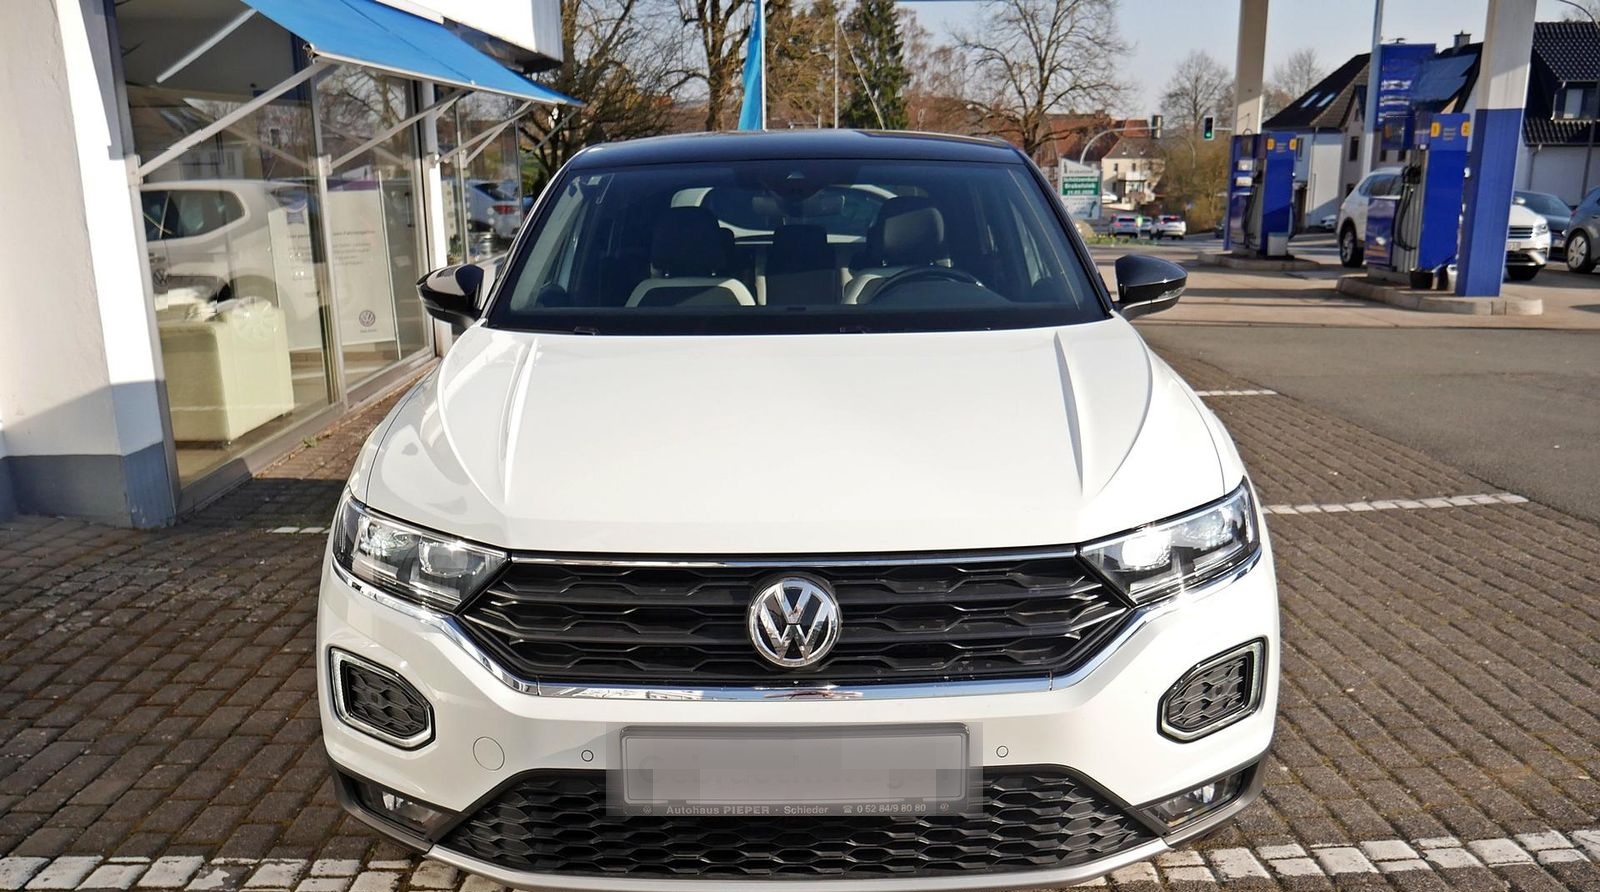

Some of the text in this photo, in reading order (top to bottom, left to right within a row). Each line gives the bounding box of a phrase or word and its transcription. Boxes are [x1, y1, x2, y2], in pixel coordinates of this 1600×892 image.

[749, 577, 840, 668] VW
[666, 805, 720, 815] Autohaus
[723, 805, 770, 815] PIEPER
[783, 805, 829, 815] Schieder
